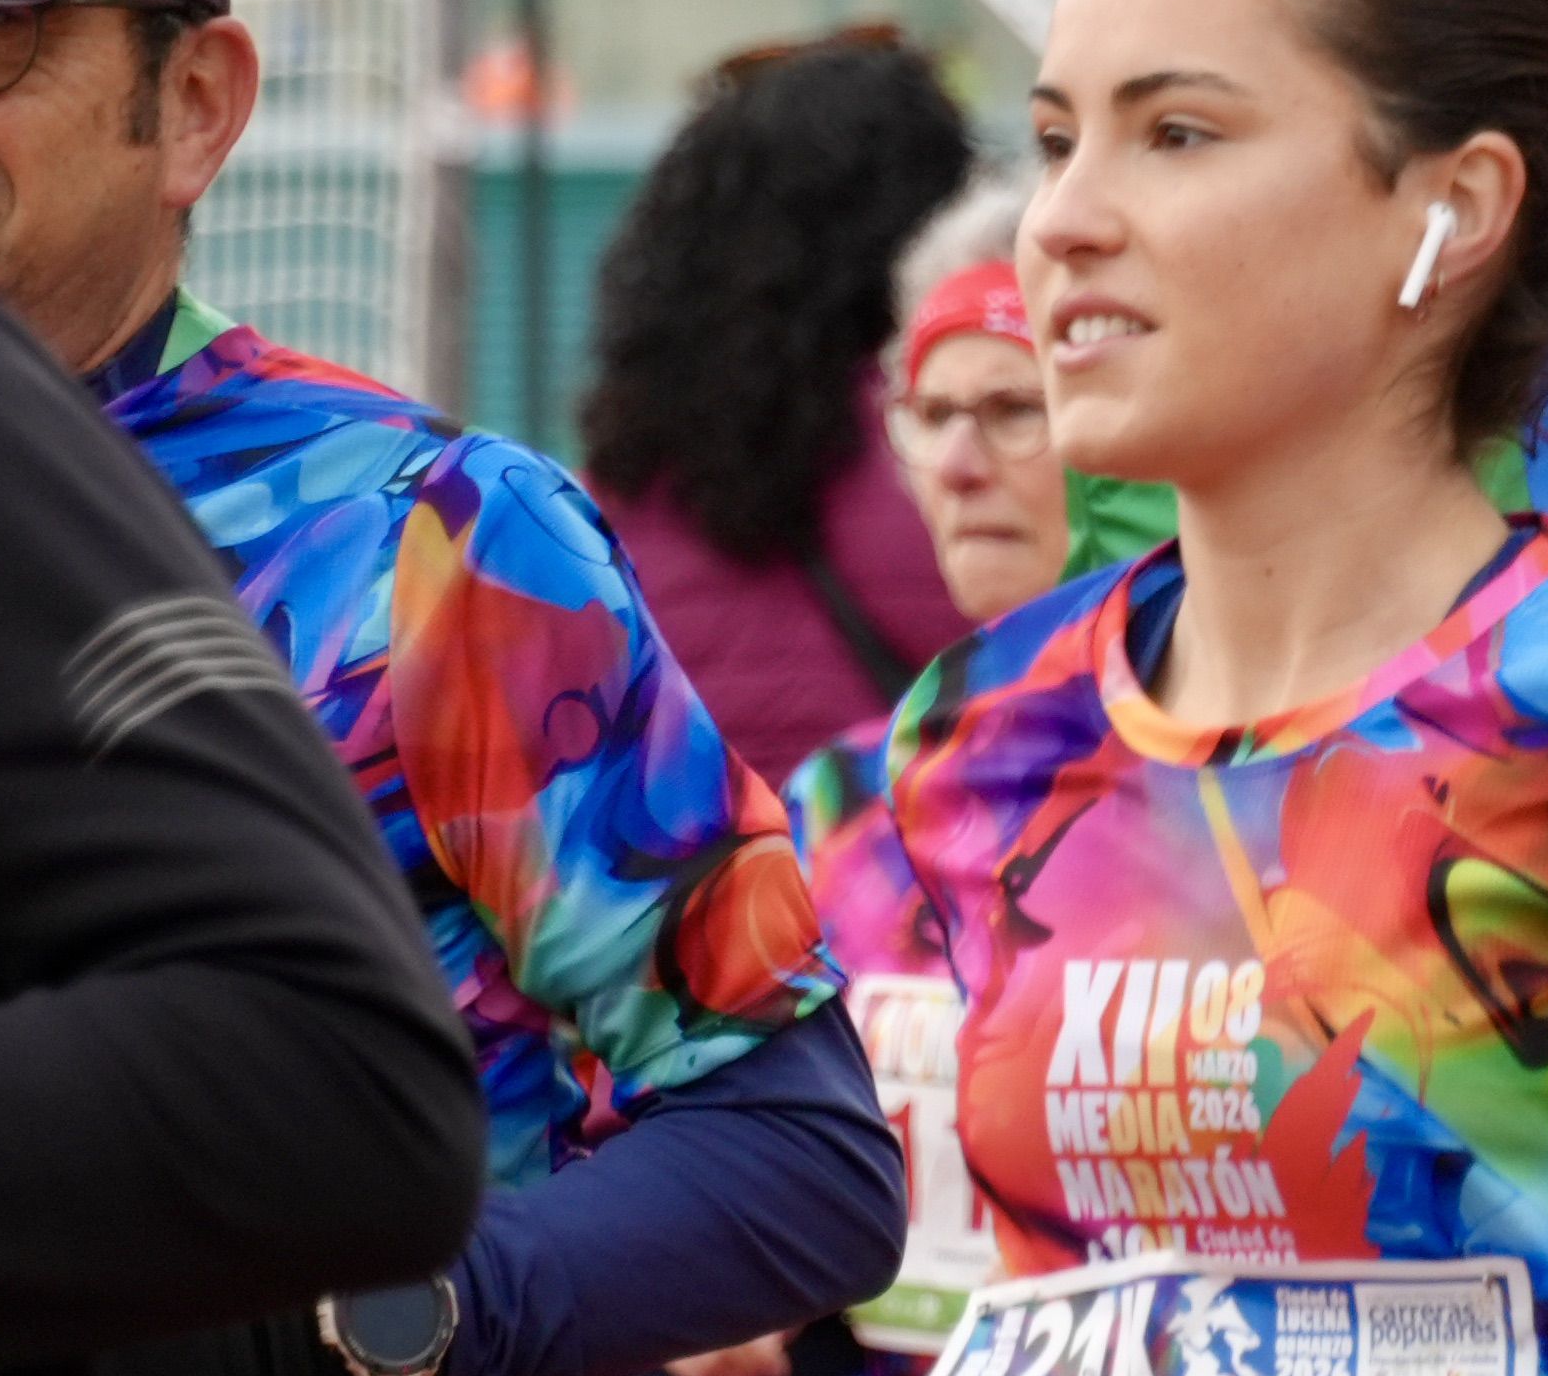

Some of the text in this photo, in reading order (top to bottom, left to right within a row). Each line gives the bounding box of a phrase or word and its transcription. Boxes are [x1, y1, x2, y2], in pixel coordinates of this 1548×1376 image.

[1046, 959, 1265, 1087] XII 08
[1185, 1049, 1258, 1085] MARZO
[1045, 1087, 1261, 1155] MEDIA 2026
[1056, 1144, 1287, 1222] MARATÓN
[1276, 1306, 1351, 1333] LUCENA
[1369, 1301, 1476, 1322] carreras
[1370, 1320, 1498, 1350] populares
